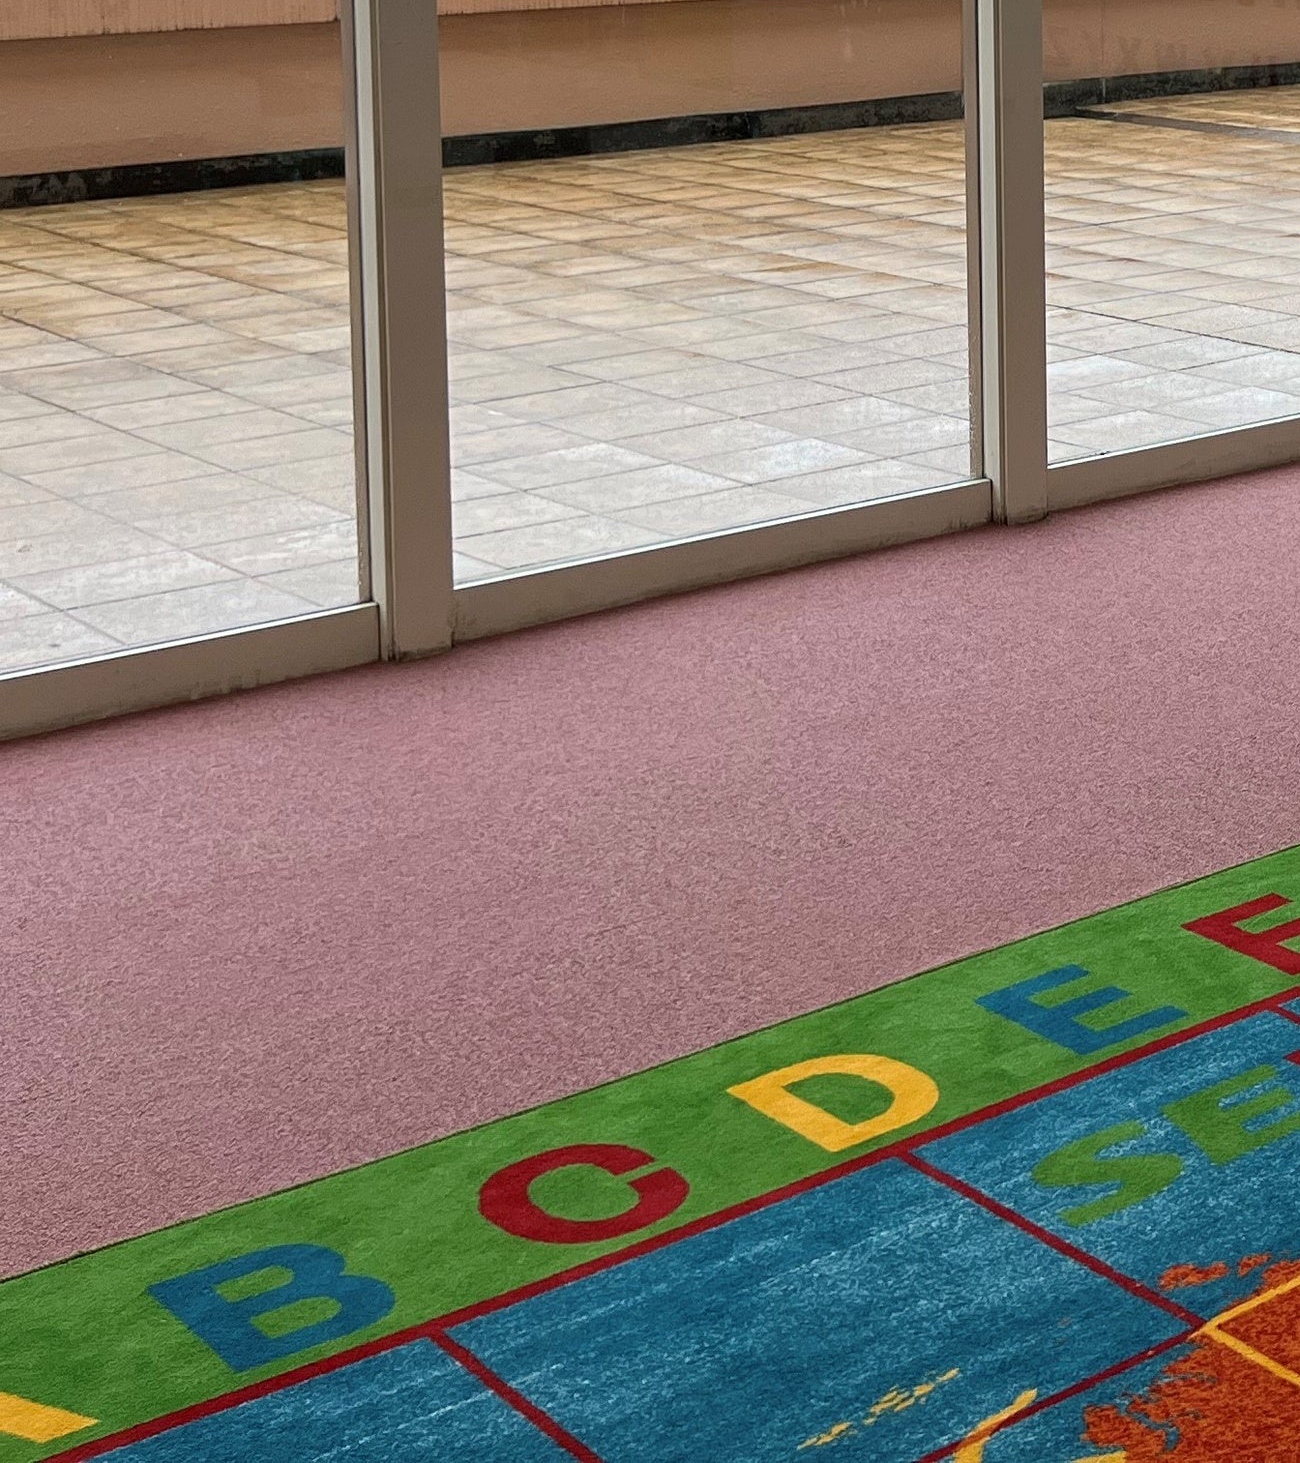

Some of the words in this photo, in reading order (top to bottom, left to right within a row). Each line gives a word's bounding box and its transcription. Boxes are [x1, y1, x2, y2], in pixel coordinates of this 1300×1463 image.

[975, 963, 1188, 1055] E
[726, 1053, 940, 1153] D
[478, 1142, 690, 1245] C
[148, 1243, 396, 1373] B
